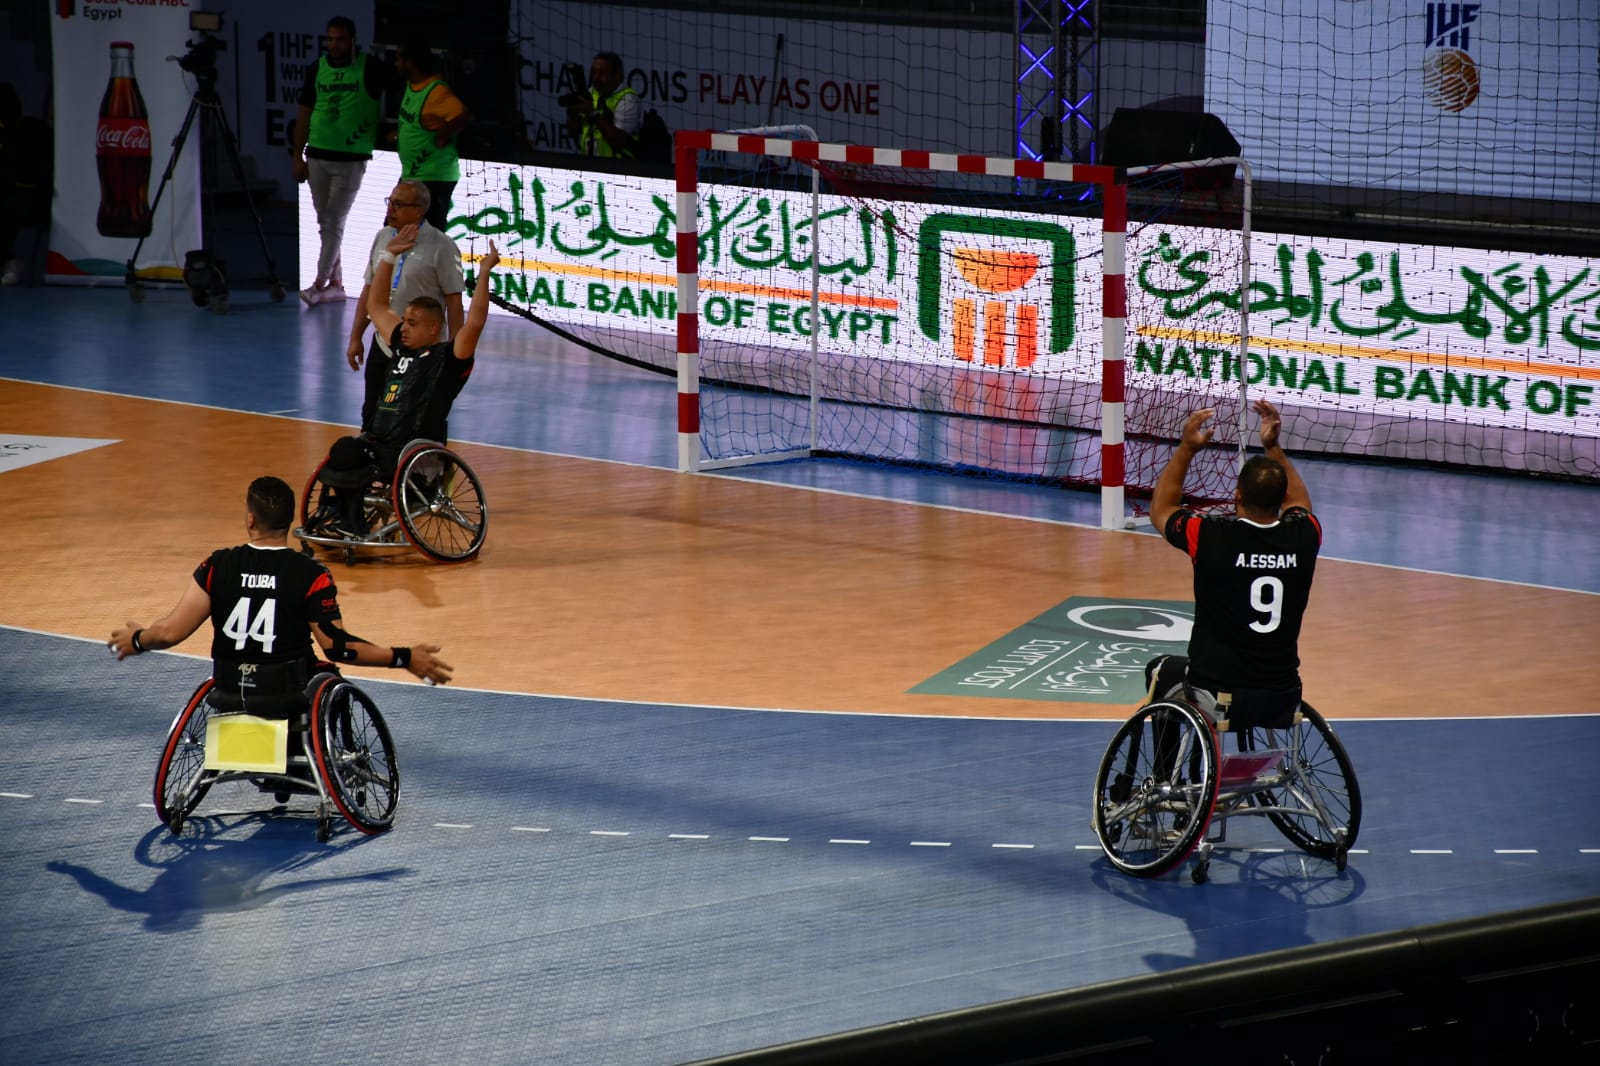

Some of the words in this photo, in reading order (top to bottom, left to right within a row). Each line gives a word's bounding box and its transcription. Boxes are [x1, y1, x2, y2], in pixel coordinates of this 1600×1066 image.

[83, 6, 122, 20] Egypt
[1425, 2, 1480, 51] IHF
[280, 32, 313, 58] IHF
[699, 73, 766, 105] PLAY
[775, 78, 811, 110] AS
[819, 80, 881, 116] ONE
[703, 296, 755, 328] OF
[767, 302, 899, 344] EGYPT
[1135, 340, 1360, 396] NATIONAL
[1375, 365, 1511, 410] BANK
[1525, 379, 1594, 418] OF
[1235, 552, 1298, 570] A.ESSAM
[222, 596, 278, 654] 44
[1248, 575, 1284, 634] 9
[997, 639, 1071, 666] EGYPT
[957, 666, 1027, 689] POST
